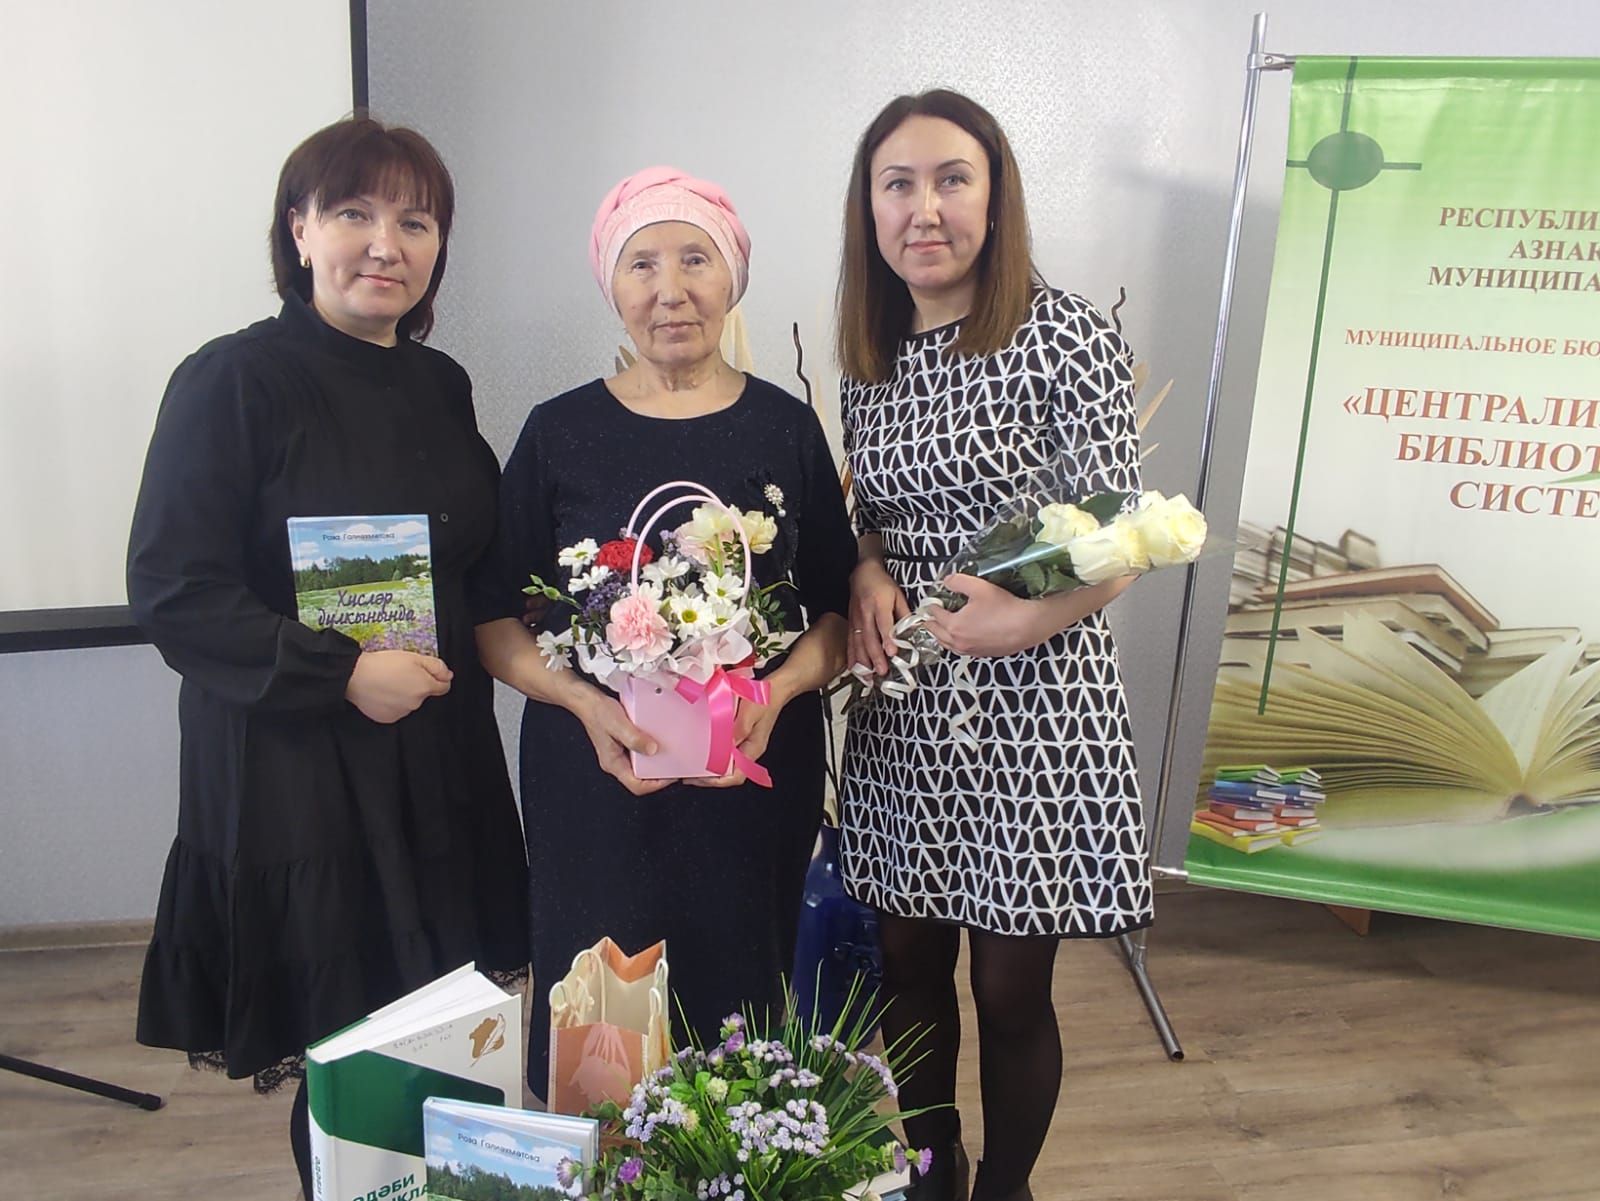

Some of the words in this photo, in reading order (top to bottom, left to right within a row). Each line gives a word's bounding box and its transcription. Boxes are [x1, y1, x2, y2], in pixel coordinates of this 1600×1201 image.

[1439, 206, 1600, 231] РЕСПУБЛИ
[1427, 266, 1600, 293] МУНИЦИПА
[1344, 328, 1557, 355] МУНИЦИПАЛЬНОЕ
[1562, 339, 1600, 359] БЮ
[1343, 387, 1600, 429] «ЦЕНТРАЛИ
[1395, 432, 1600, 474] БИБЛИОТ
[1449, 480, 1600, 519] СИСТЕ
